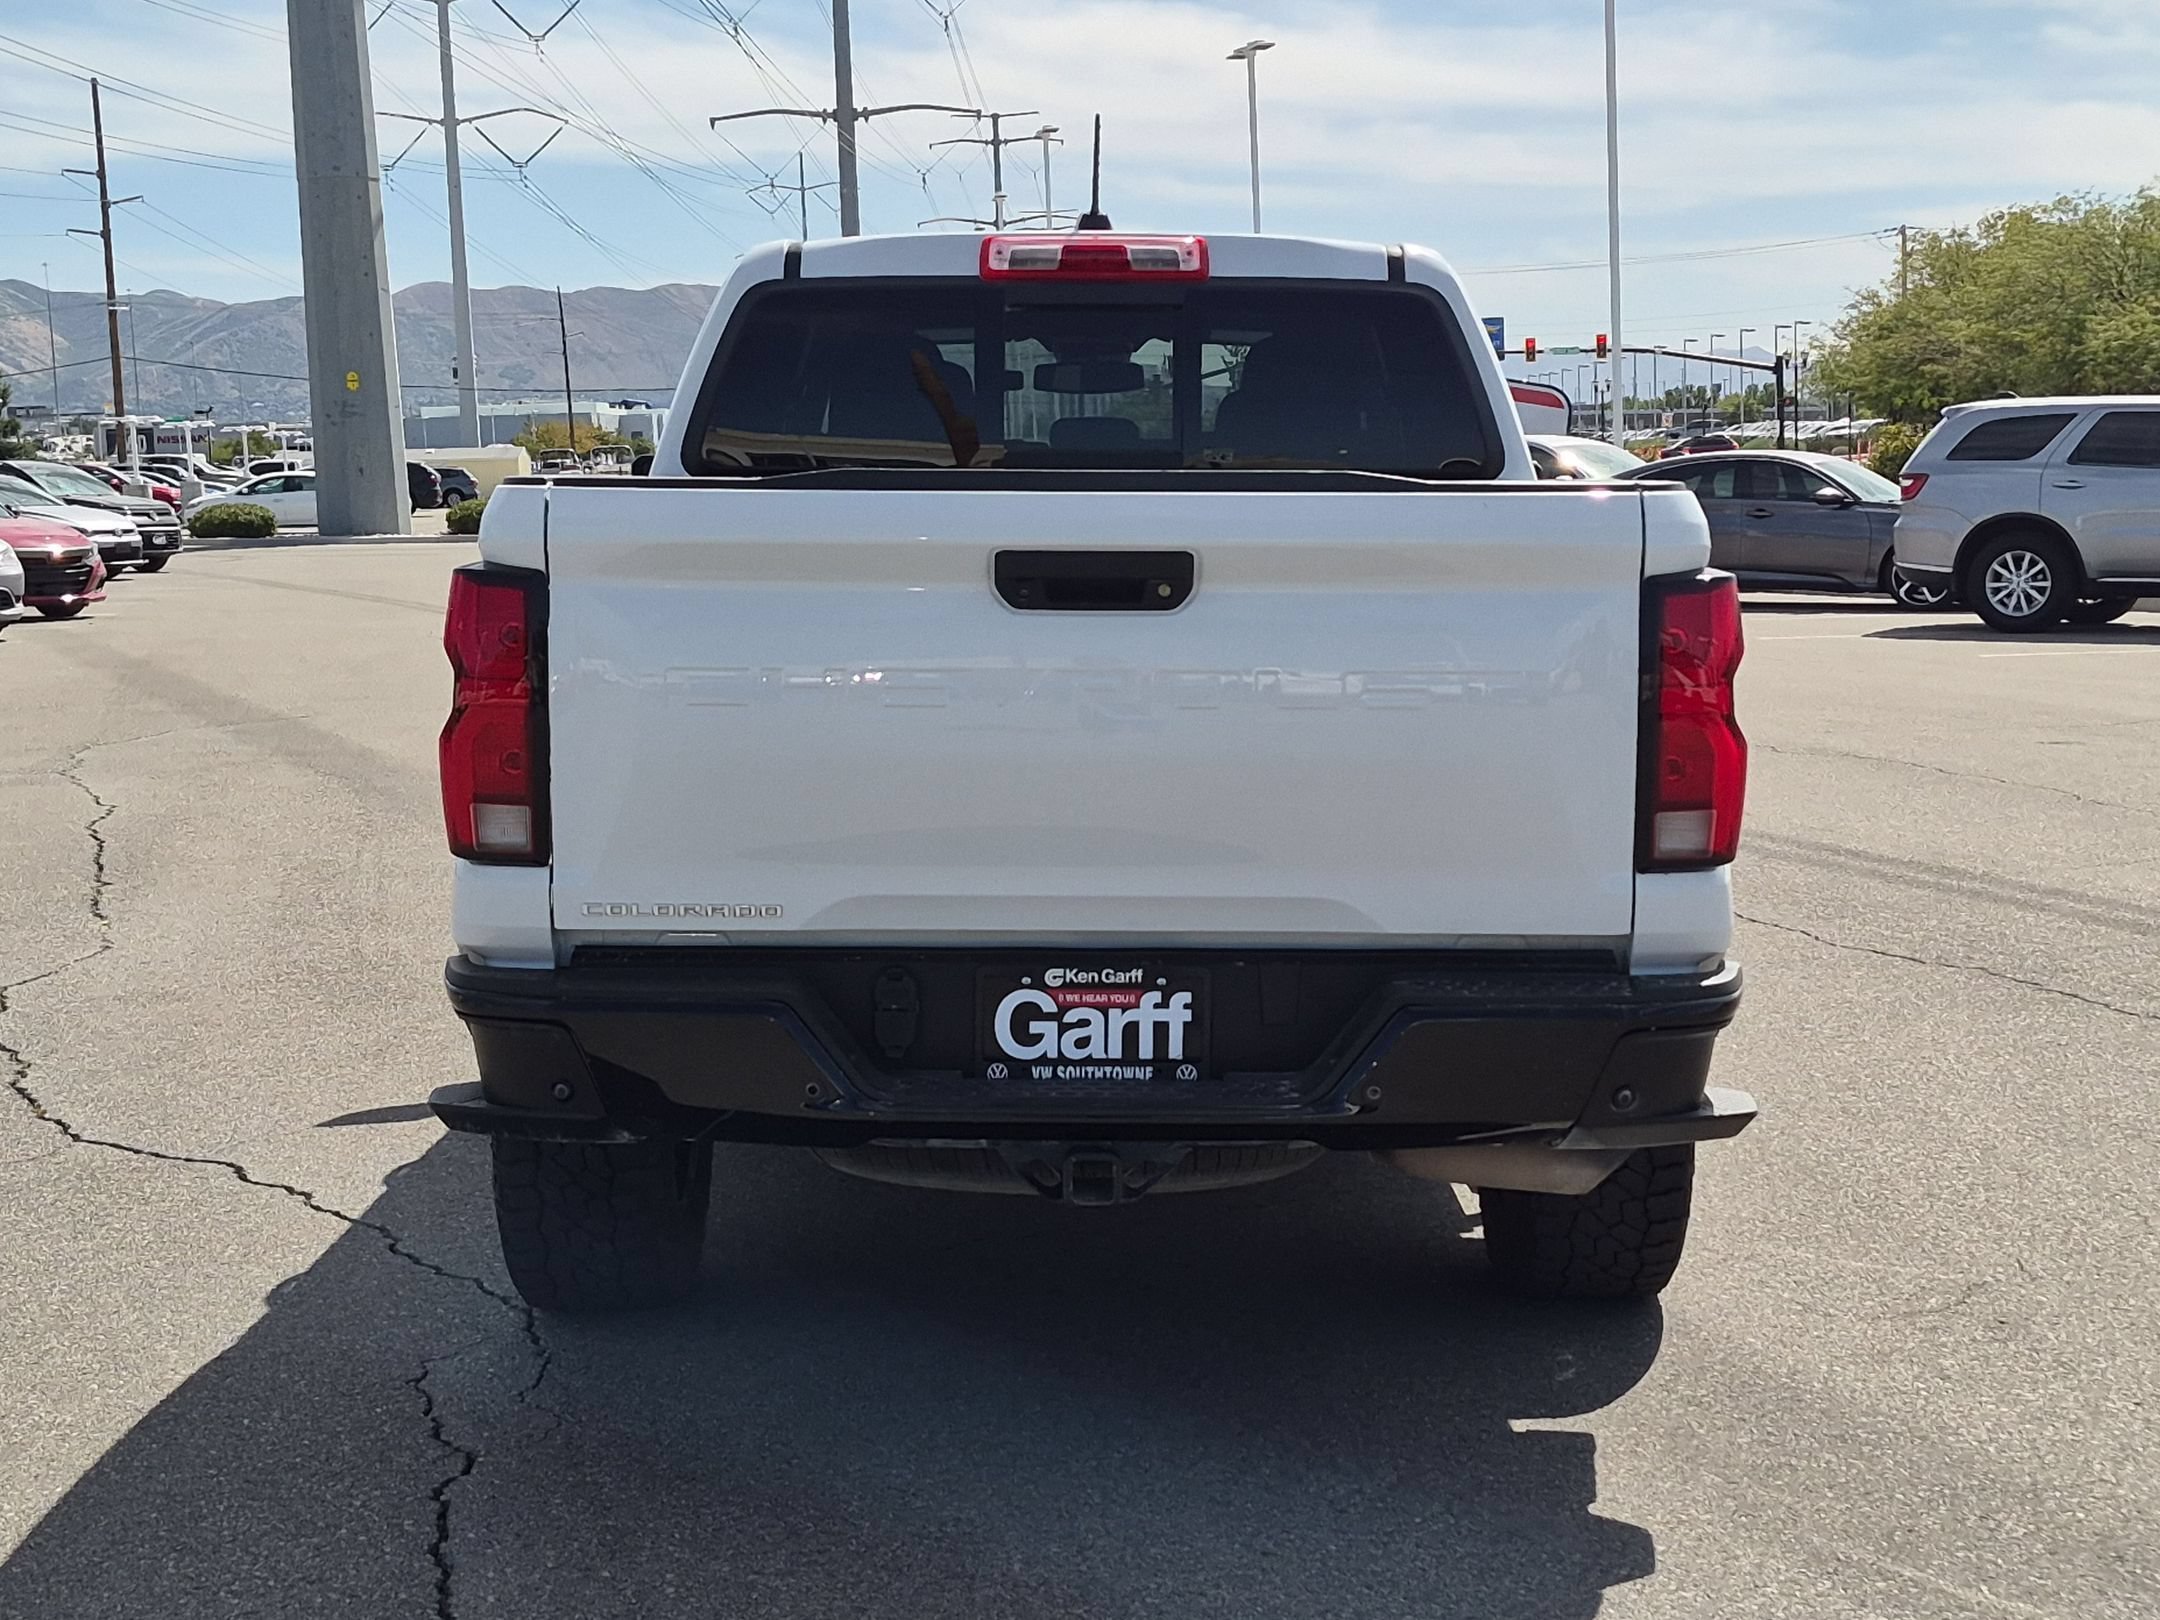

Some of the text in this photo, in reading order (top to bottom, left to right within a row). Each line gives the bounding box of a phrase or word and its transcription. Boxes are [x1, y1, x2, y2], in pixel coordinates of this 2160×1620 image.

[581, 903, 784, 919] COLORADO
[1065, 968, 1143, 984] Ken Garff
[1065, 994, 1129, 1003] WE HEAR YOU
[994, 988, 1193, 1060] Garff
[1031, 1065, 1053, 1080] VW
